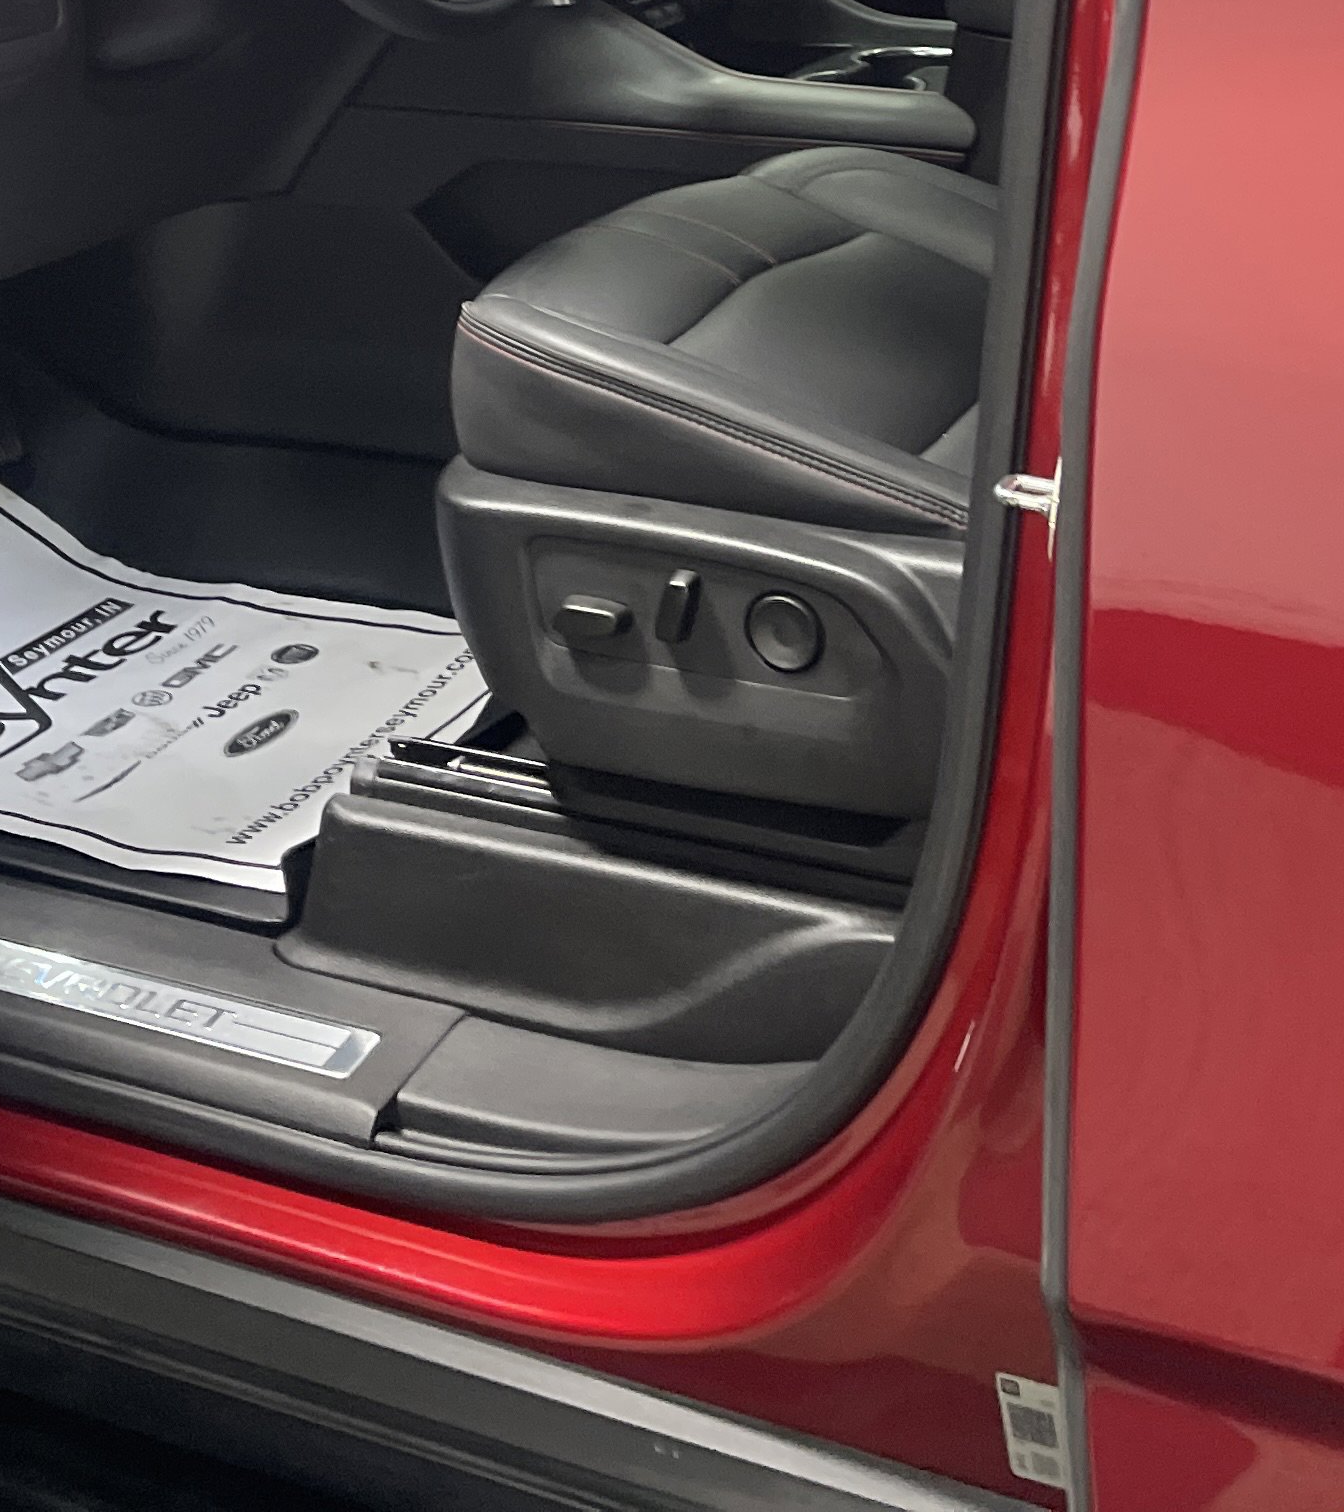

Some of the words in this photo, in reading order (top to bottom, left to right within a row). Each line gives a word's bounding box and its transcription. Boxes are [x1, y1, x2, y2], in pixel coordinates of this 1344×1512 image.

[99, 600, 123, 620] IN
[183, 615, 215, 642] 1979
[162, 642, 238, 689] GMC
[203, 683, 262, 718] Jeep
